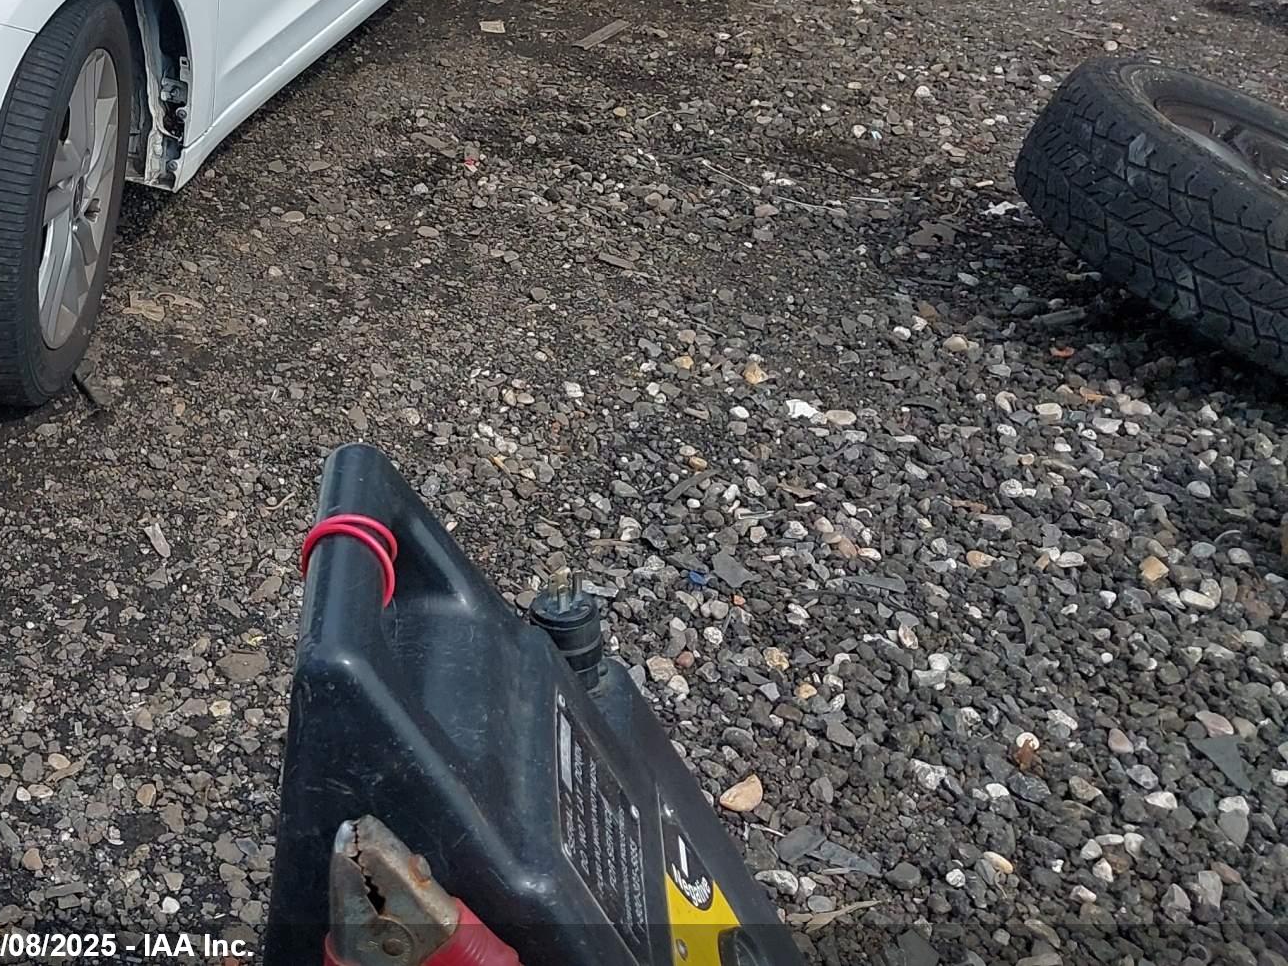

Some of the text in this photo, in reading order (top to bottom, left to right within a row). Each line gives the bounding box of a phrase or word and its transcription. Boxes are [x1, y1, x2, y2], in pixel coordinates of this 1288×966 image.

[574, 740, 590, 876] DO NOT LAY DOWN
